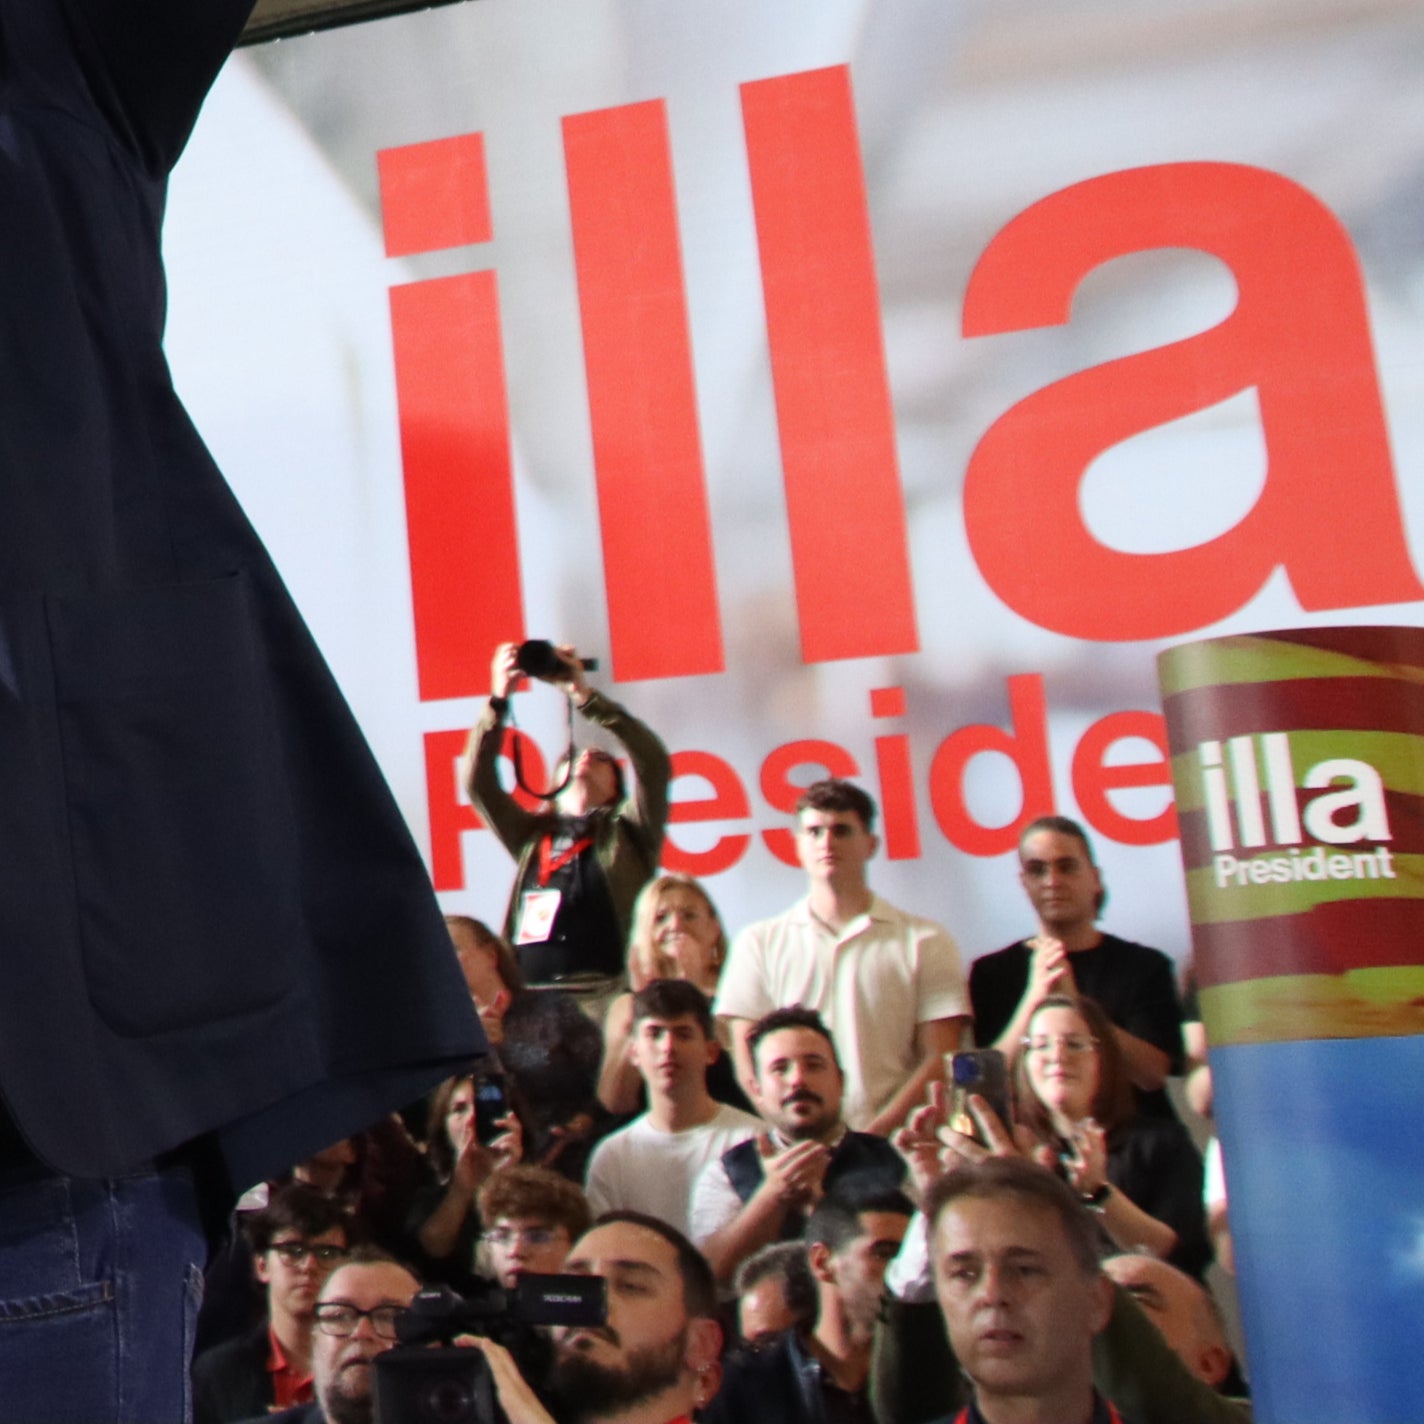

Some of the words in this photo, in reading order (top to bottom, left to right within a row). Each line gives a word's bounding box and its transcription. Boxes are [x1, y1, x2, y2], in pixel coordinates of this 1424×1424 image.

[378, 64, 1424, 702] illa
[423, 674, 1182, 891] Peside
[1198, 733, 1392, 851] illa
[1212, 847, 1397, 889] President
